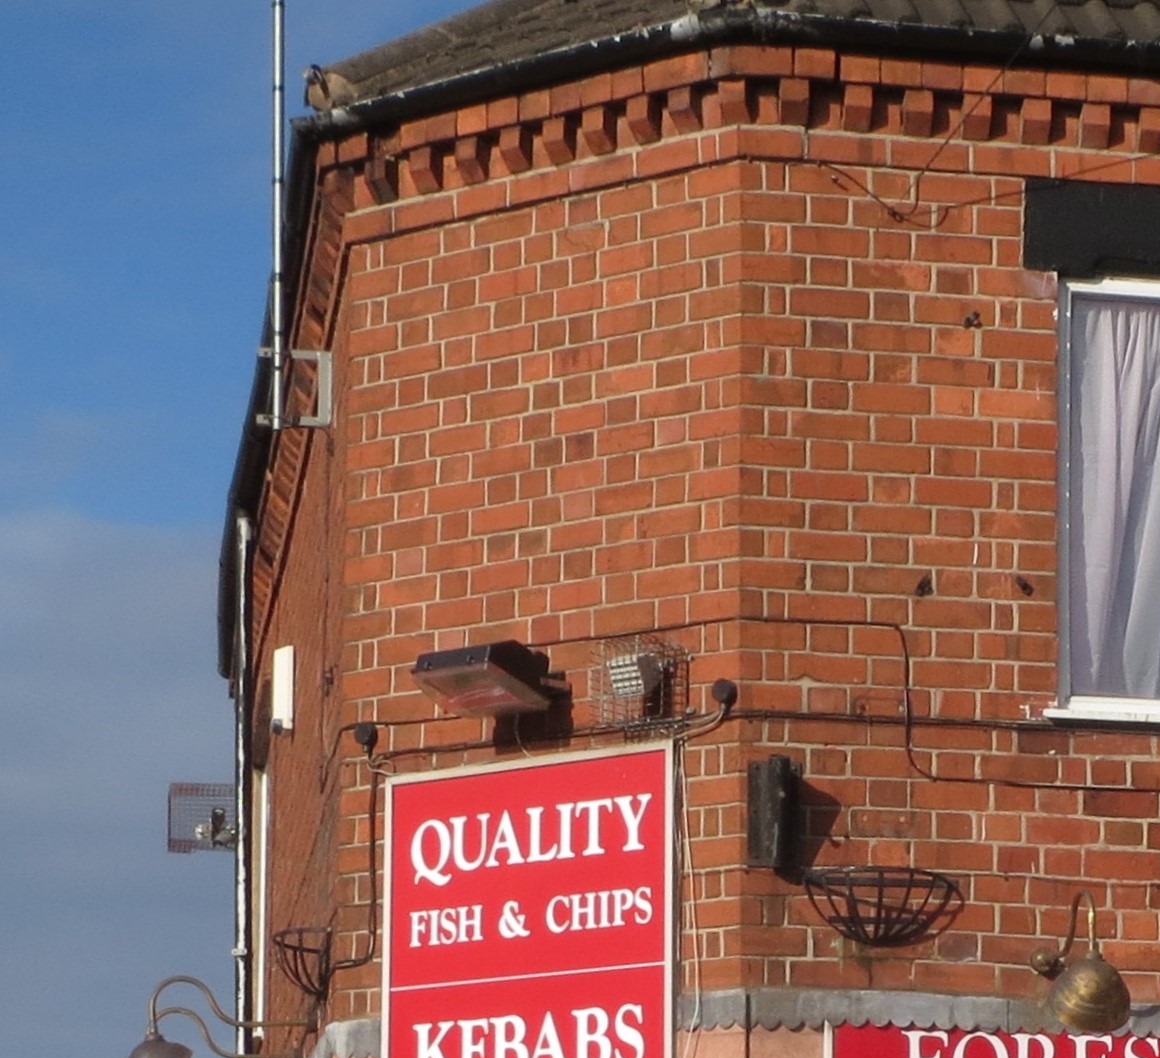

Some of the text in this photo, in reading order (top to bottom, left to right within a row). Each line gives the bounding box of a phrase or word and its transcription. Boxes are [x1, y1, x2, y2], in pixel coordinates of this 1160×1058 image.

[410, 793, 652, 886] QUALITY
[409, 887, 653, 948] FISH & CHIPS
